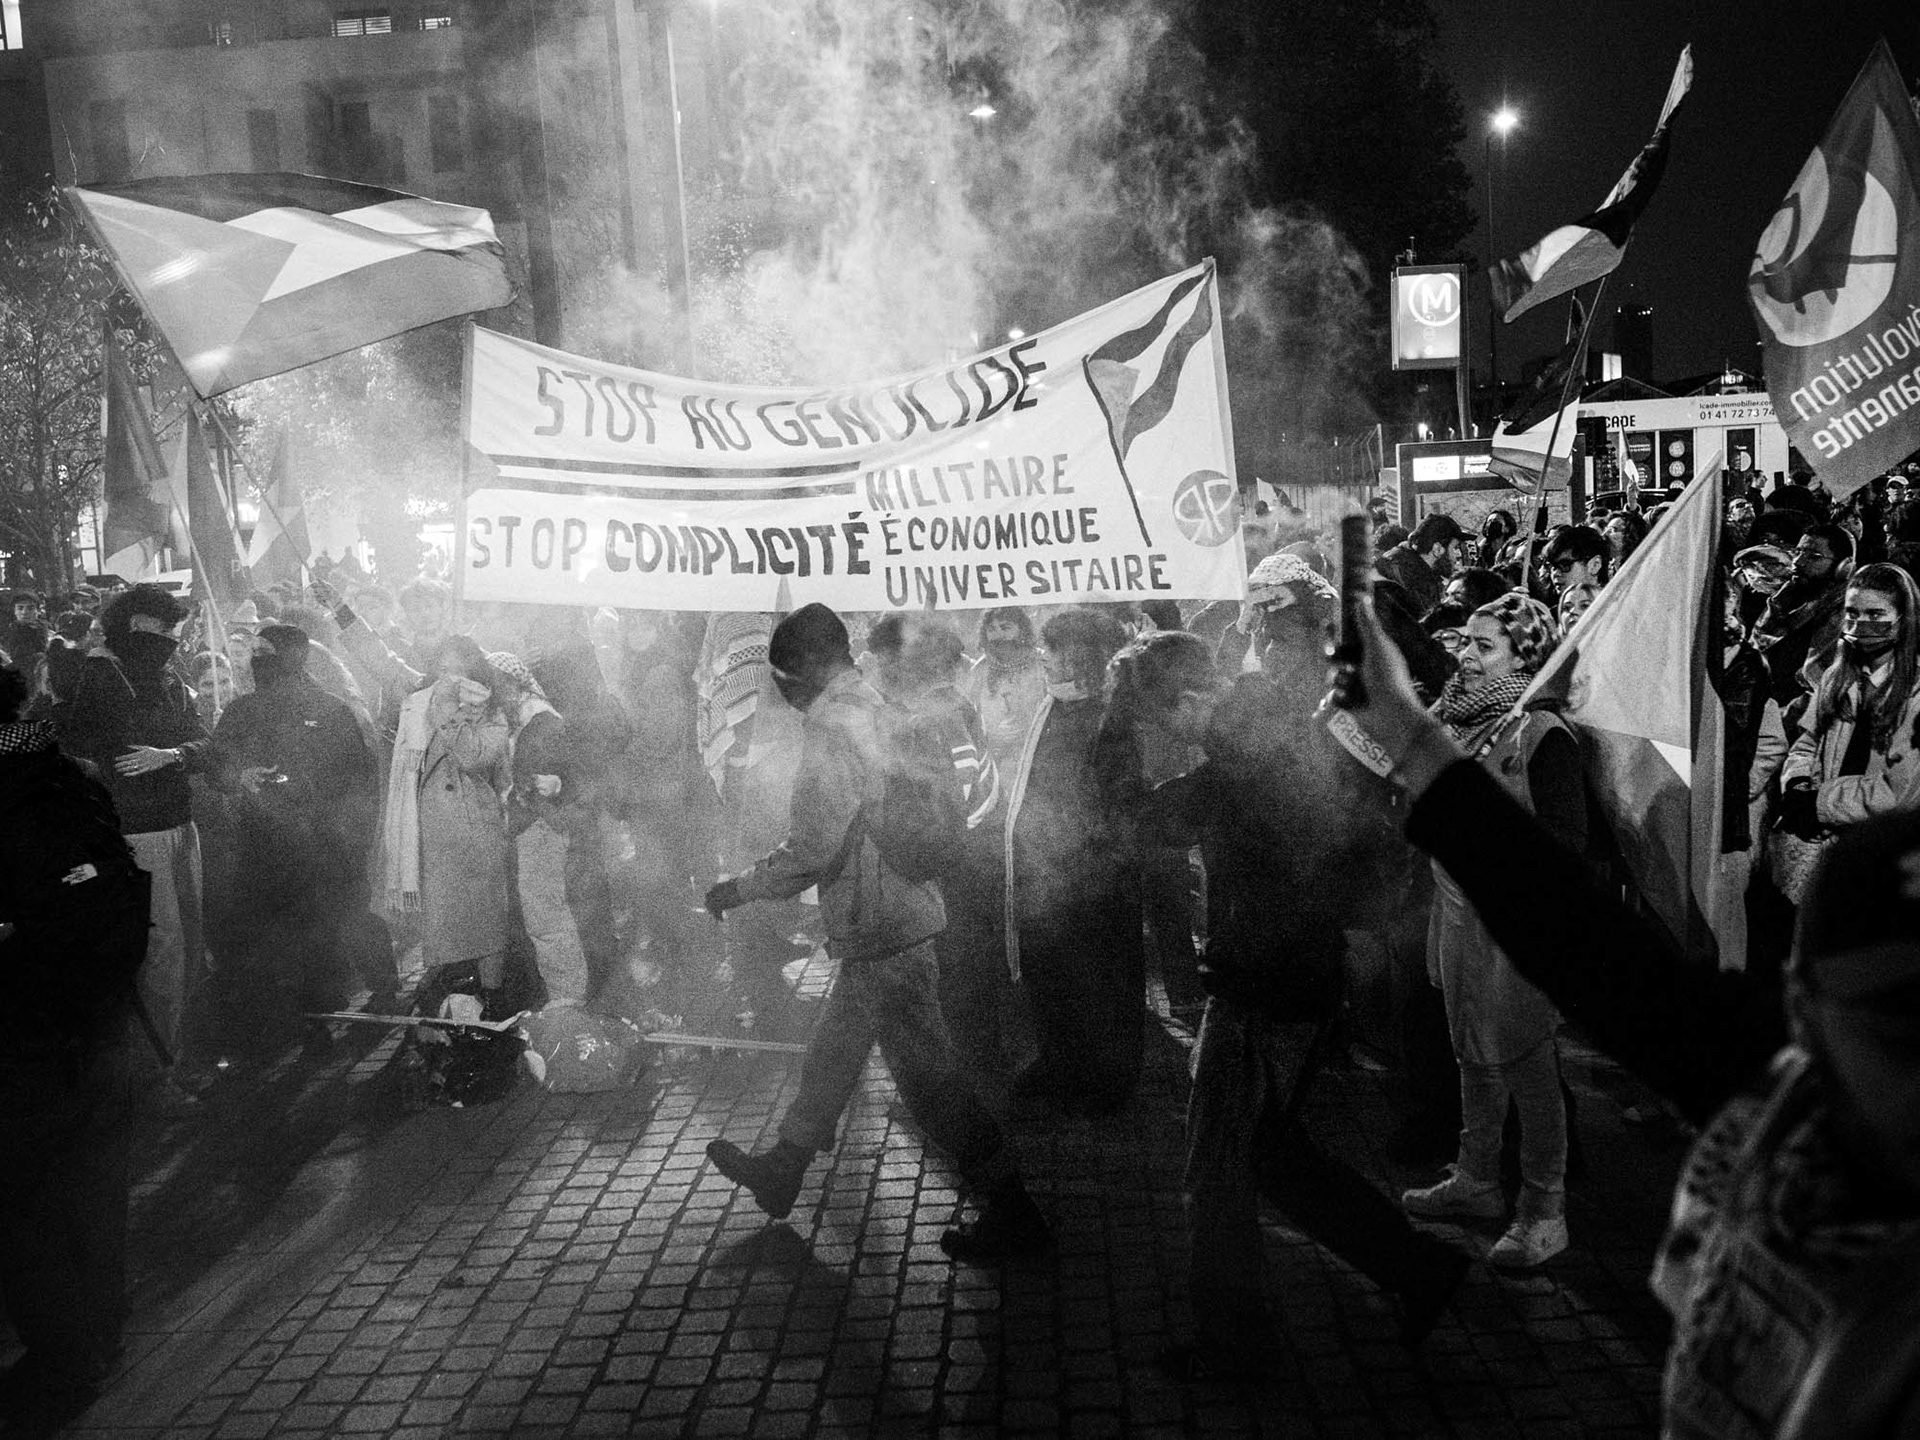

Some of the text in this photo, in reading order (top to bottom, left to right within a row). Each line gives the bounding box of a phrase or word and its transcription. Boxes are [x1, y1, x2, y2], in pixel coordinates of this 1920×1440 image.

[1422, 282, 1452, 314] M
[534, 366, 658, 444] STOP
[681, 395, 751, 451] AU
[1700, 410, 1711, 420] 01
[1715, 410, 1727, 419] 41
[1732, 408, 1744, 418] 72
[1748, 407, 1760, 417] 73
[866, 453, 1075, 512] MILITAIRE
[470, 511, 870, 577] STOP COMPLICITÉ
[880, 507, 1101, 555] ÉCONOMIQUE
[1333, 713, 1392, 769] PRESSE
